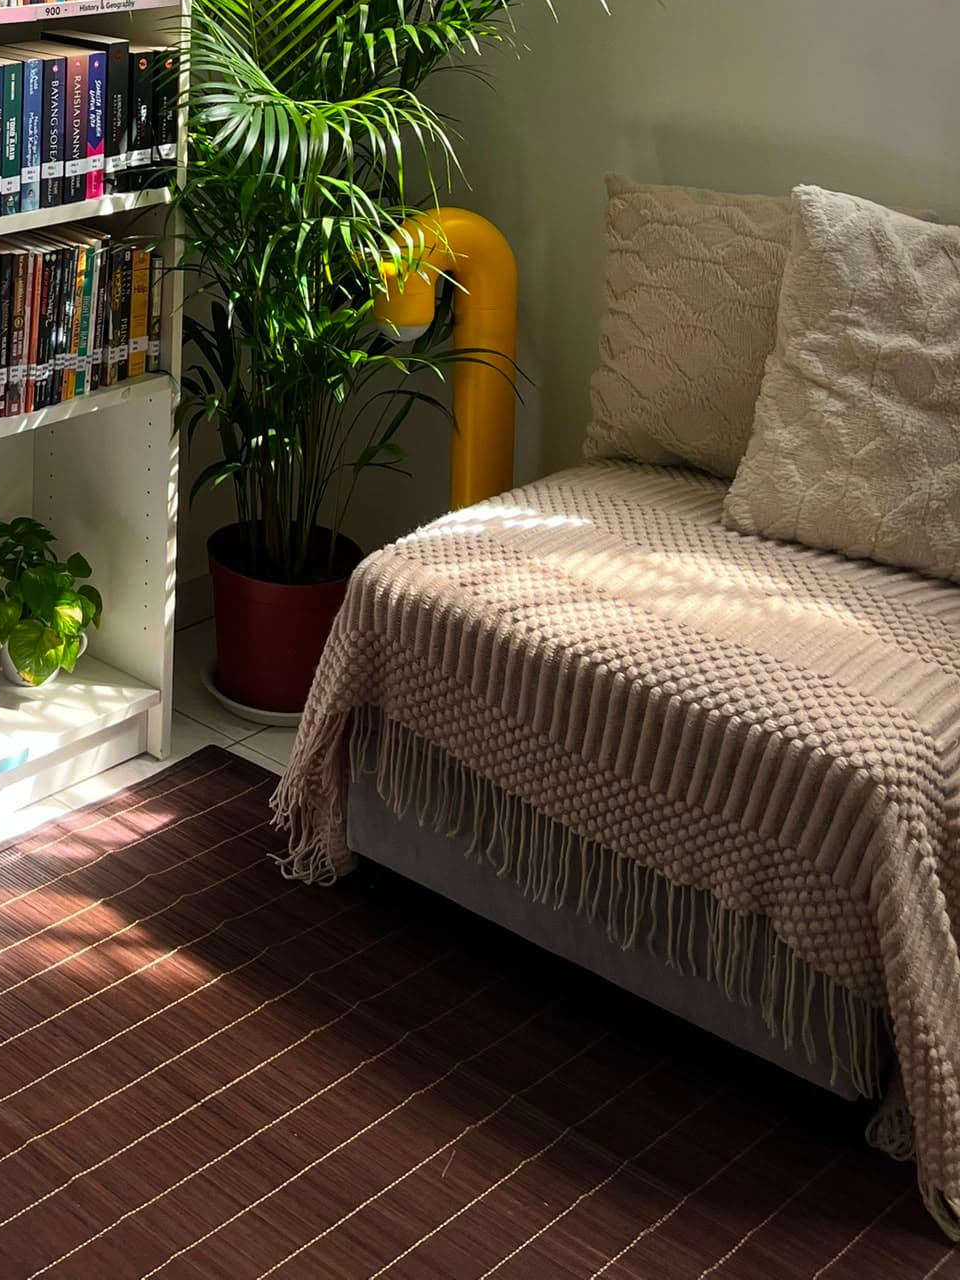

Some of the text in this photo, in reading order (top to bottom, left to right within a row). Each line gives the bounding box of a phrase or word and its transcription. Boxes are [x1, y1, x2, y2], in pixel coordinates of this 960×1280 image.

[45, 6, 62, 17] 900
[79, 0, 135, 14] History Geography
[50, 80, 59, 126] BAYANG
[73, 75, 81, 116] RAHSIA
